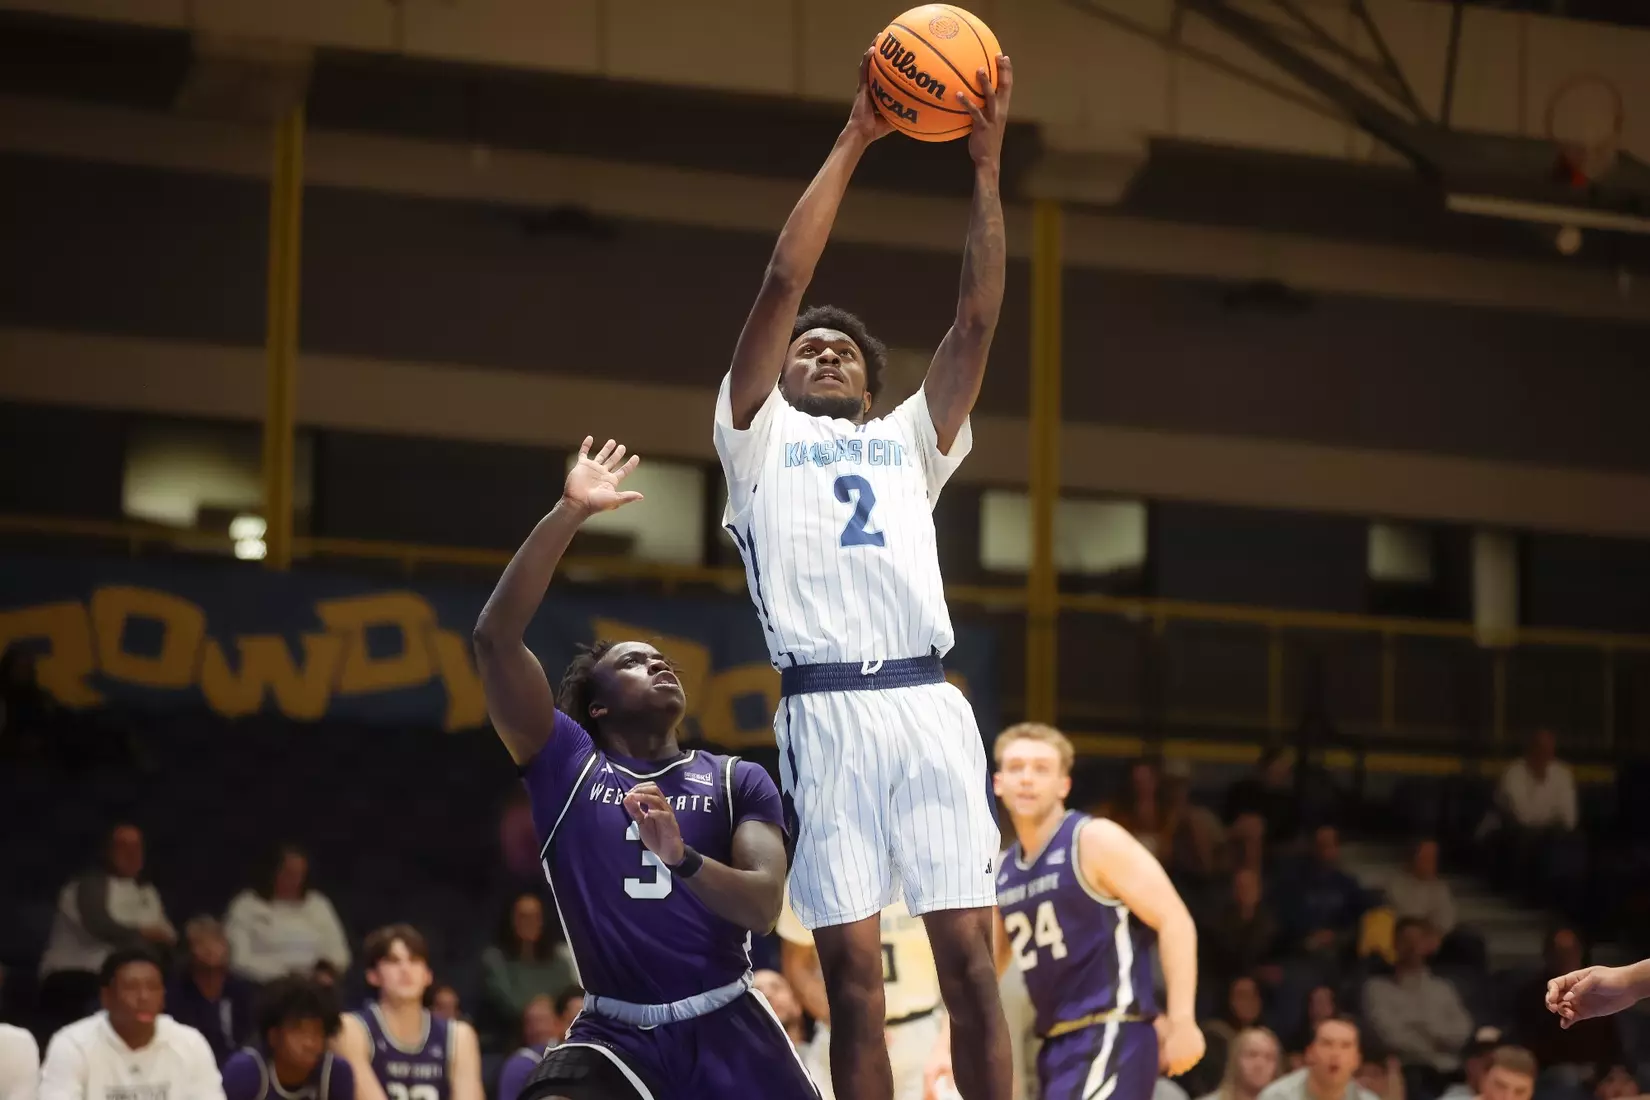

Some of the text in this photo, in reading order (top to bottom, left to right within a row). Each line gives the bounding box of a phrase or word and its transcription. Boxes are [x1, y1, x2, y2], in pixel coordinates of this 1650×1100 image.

[871, 77, 919, 124] NCAA
[879, 31, 947, 101] Wilson
[868, 438, 912, 468] CIT
[833, 473, 886, 548] 2
[589, 782, 713, 814] WEB TATE
[623, 820, 673, 900] 3
[1004, 900, 1068, 972] 24
